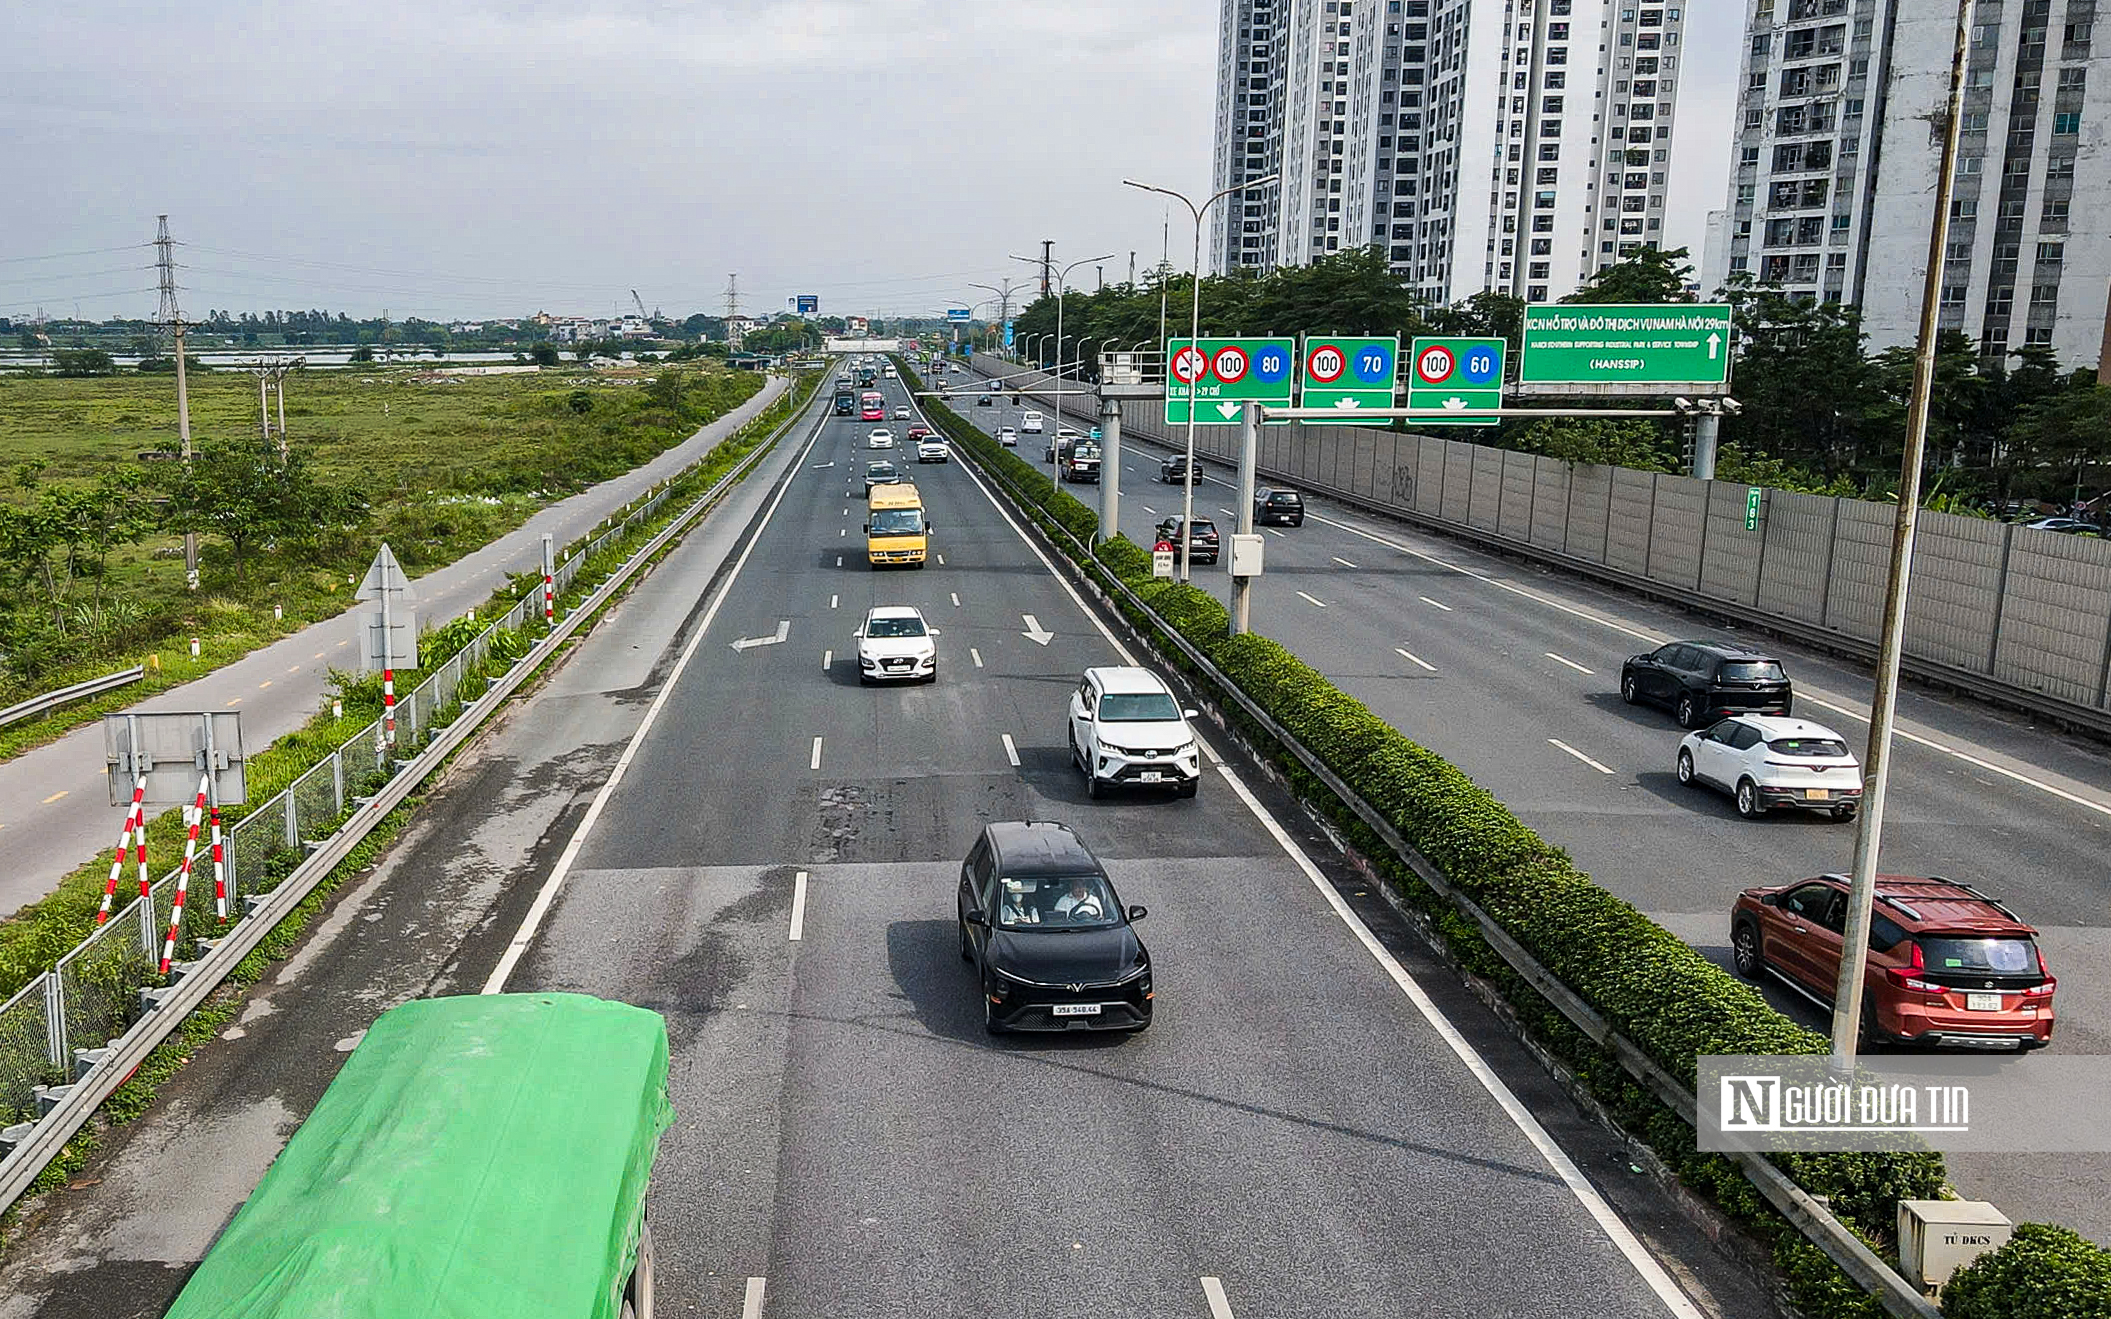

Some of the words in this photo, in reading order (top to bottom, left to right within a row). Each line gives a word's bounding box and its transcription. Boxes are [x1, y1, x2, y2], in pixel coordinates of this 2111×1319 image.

[1526, 318, 1545, 330] KCN
[1560, 317, 1577, 332] TRỢ
[1578, 315, 1589, 330] VÀ
[1589, 316, 1604, 330] ĐÔ
[1617, 318, 1639, 332] DỊCH
[1640, 318, 1653, 332] VỤ
[1653, 318, 1674, 330] NAM
[1674, 315, 1687, 330] HÀ
[1688, 315, 1703, 332] NỘI
[1704, 317, 1729, 330] 29km
[1221, 357, 1242, 373] 100
[1262, 356, 1280, 373] 80
[1316, 356, 1338, 372] 100
[1363, 356, 1382, 373] 70
[1426, 356, 1448, 372] 100
[1470, 356, 1490, 373] 60
[1589, 359, 1645, 369] (HANSSIP)
